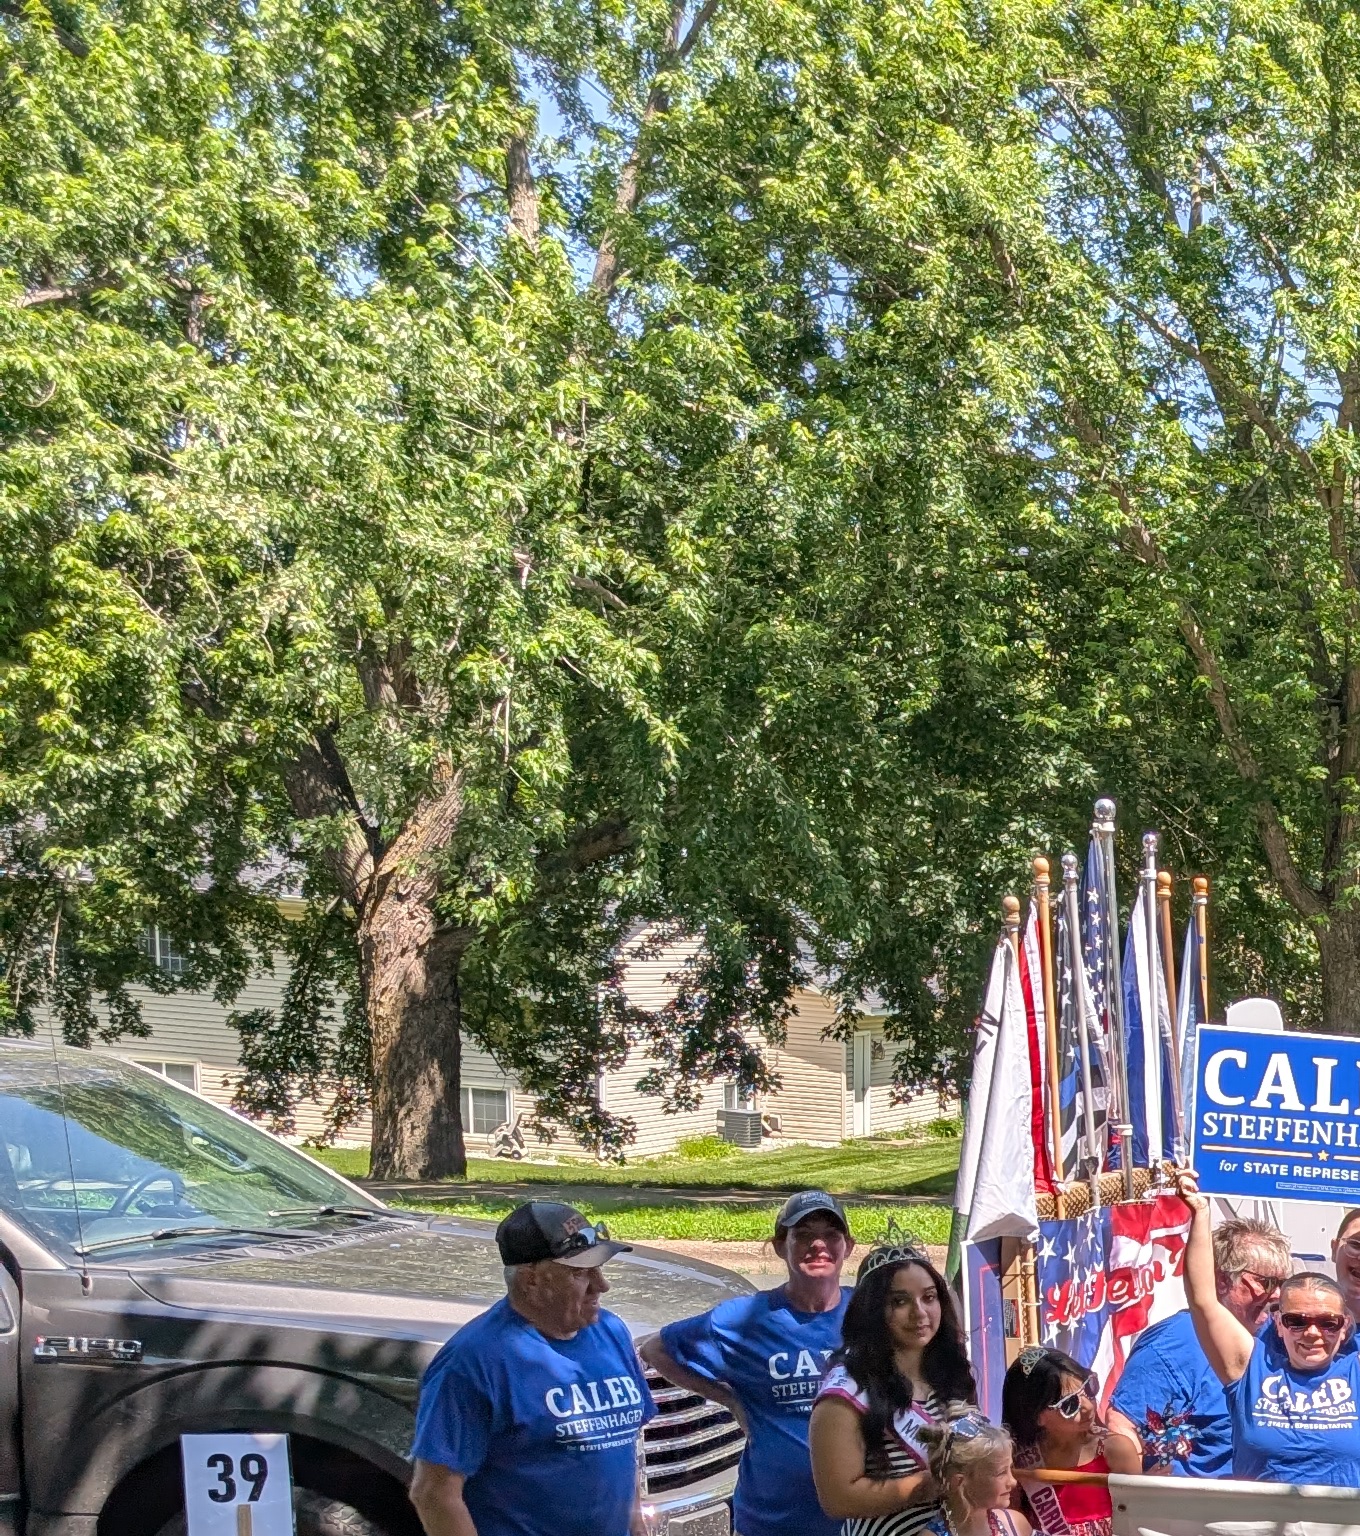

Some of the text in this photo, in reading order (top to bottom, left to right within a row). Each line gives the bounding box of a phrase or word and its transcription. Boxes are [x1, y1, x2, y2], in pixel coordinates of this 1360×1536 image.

[1219, 1160, 1238, 1172] for
[1243, 1161, 1289, 1176] STATE
[545, 1376, 642, 1418] CALEB
[1262, 1375, 1351, 1413] CALEB
[207, 1453, 268, 1503] 39
